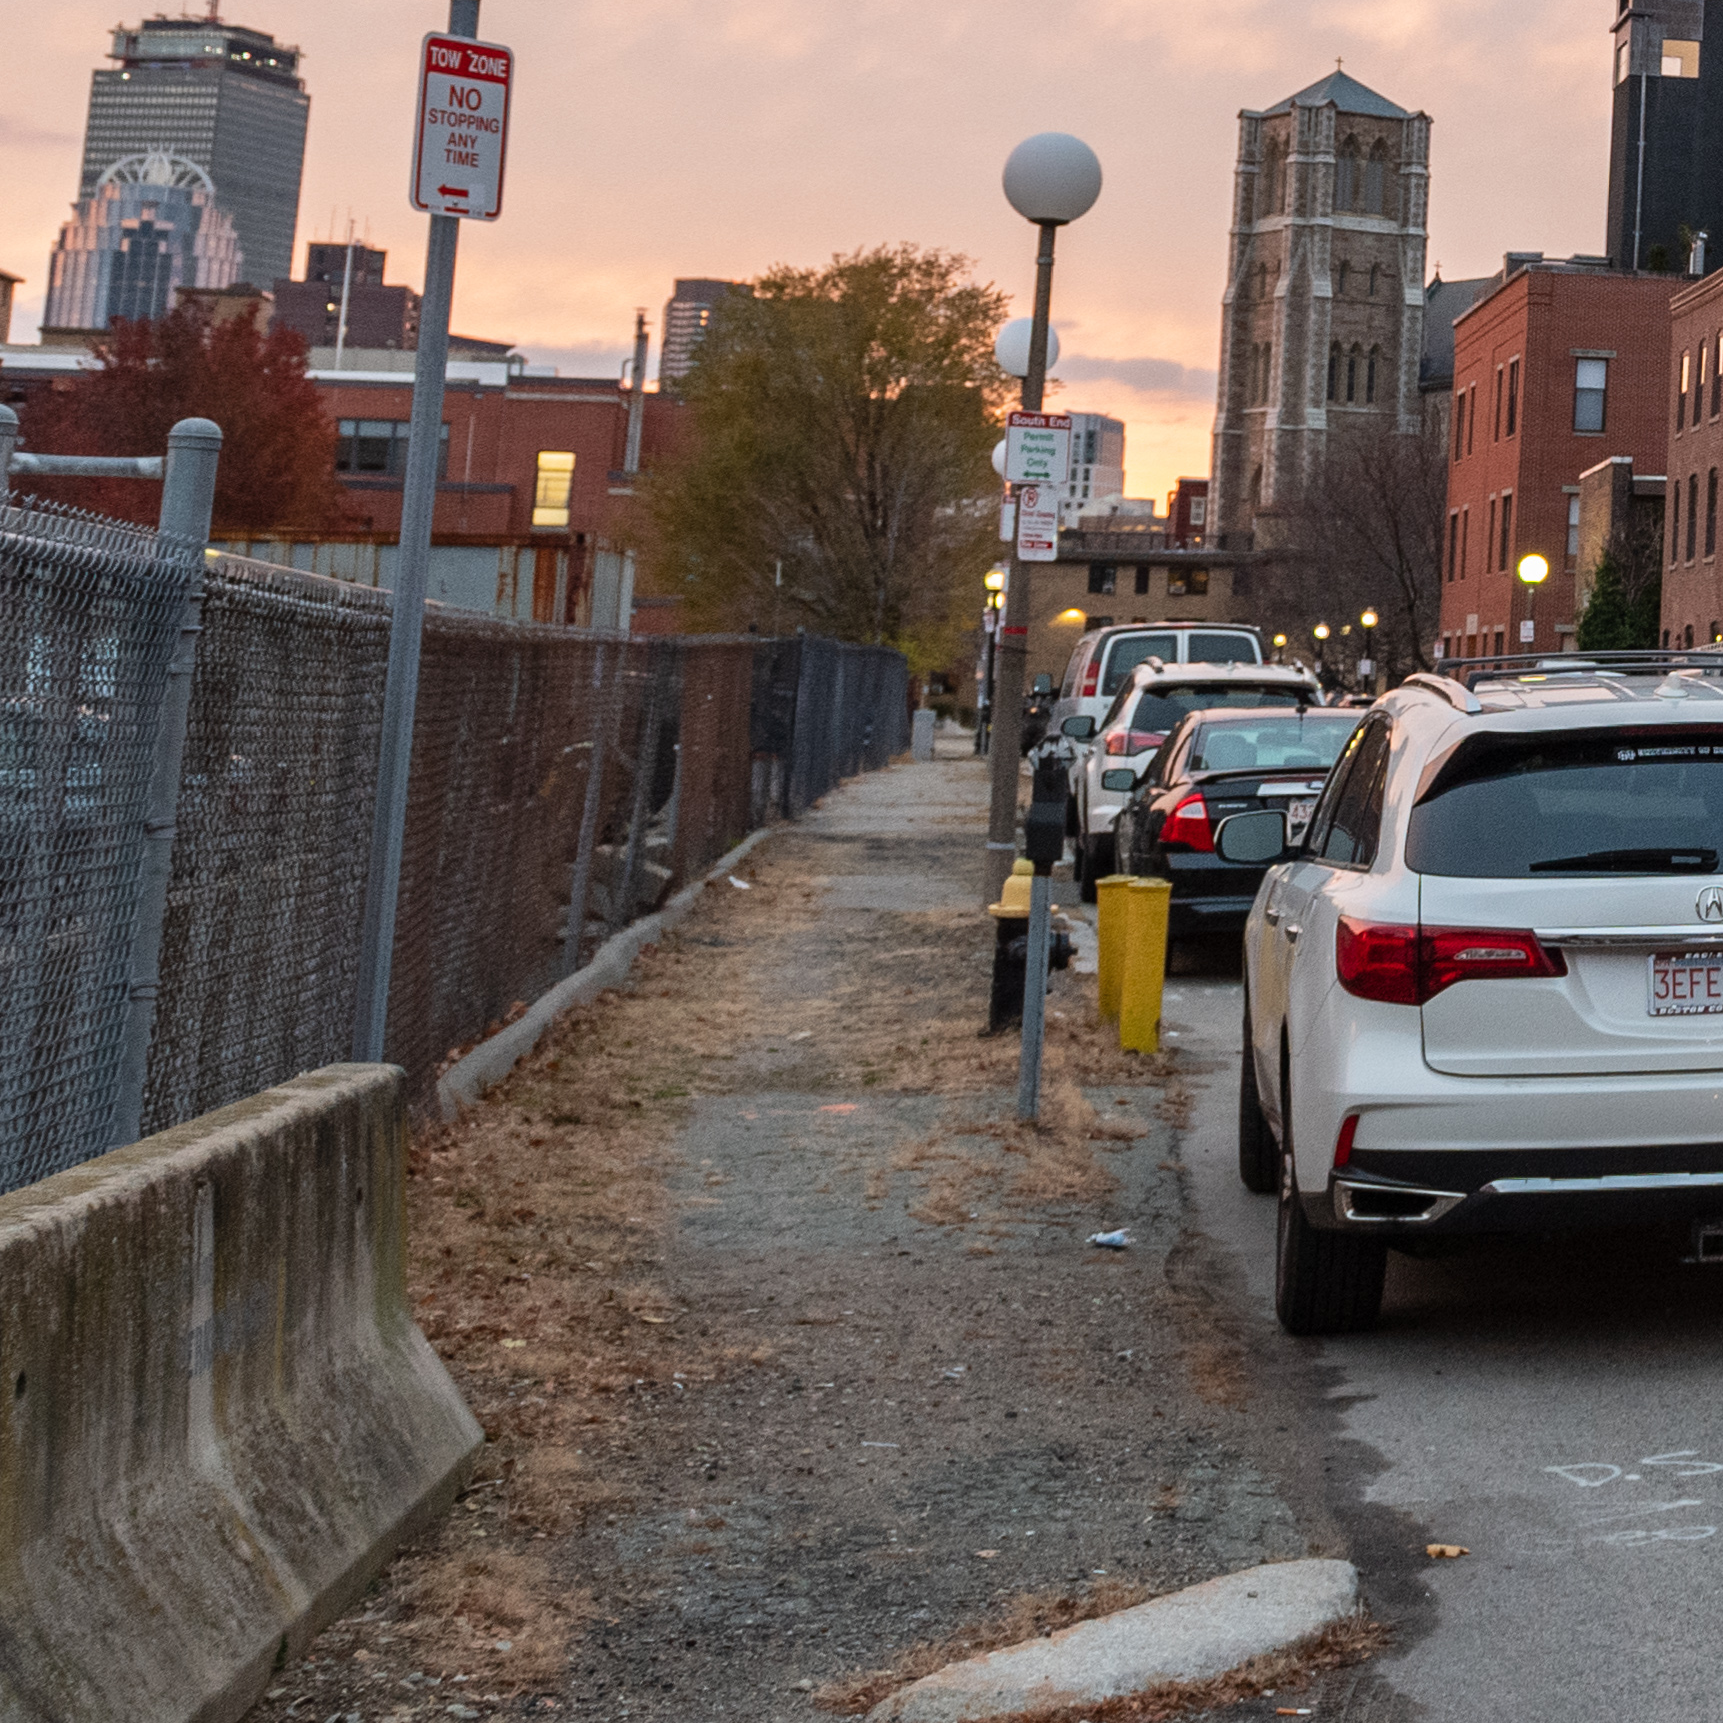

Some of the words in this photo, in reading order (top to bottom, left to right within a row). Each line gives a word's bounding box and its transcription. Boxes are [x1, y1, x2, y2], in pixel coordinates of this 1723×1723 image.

[430, 46, 462, 70] TOW
[468, 53, 508, 77] ZONE
[449, 84, 482, 112] NO
[428, 108, 500, 134] STOPPING
[447, 133, 478, 151] ANY
[444, 149, 480, 168] TIME
[1012, 413, 1046, 426] South
[1049, 417, 1070, 428] End
[1023, 431, 1054, 442] Permit
[1020, 444, 1056, 456] Parking
[1026, 457, 1048, 468] Only
[1654, 966, 1722, 1000] 3EFE
[1660, 1006, 1706, 1015] BOSTON
